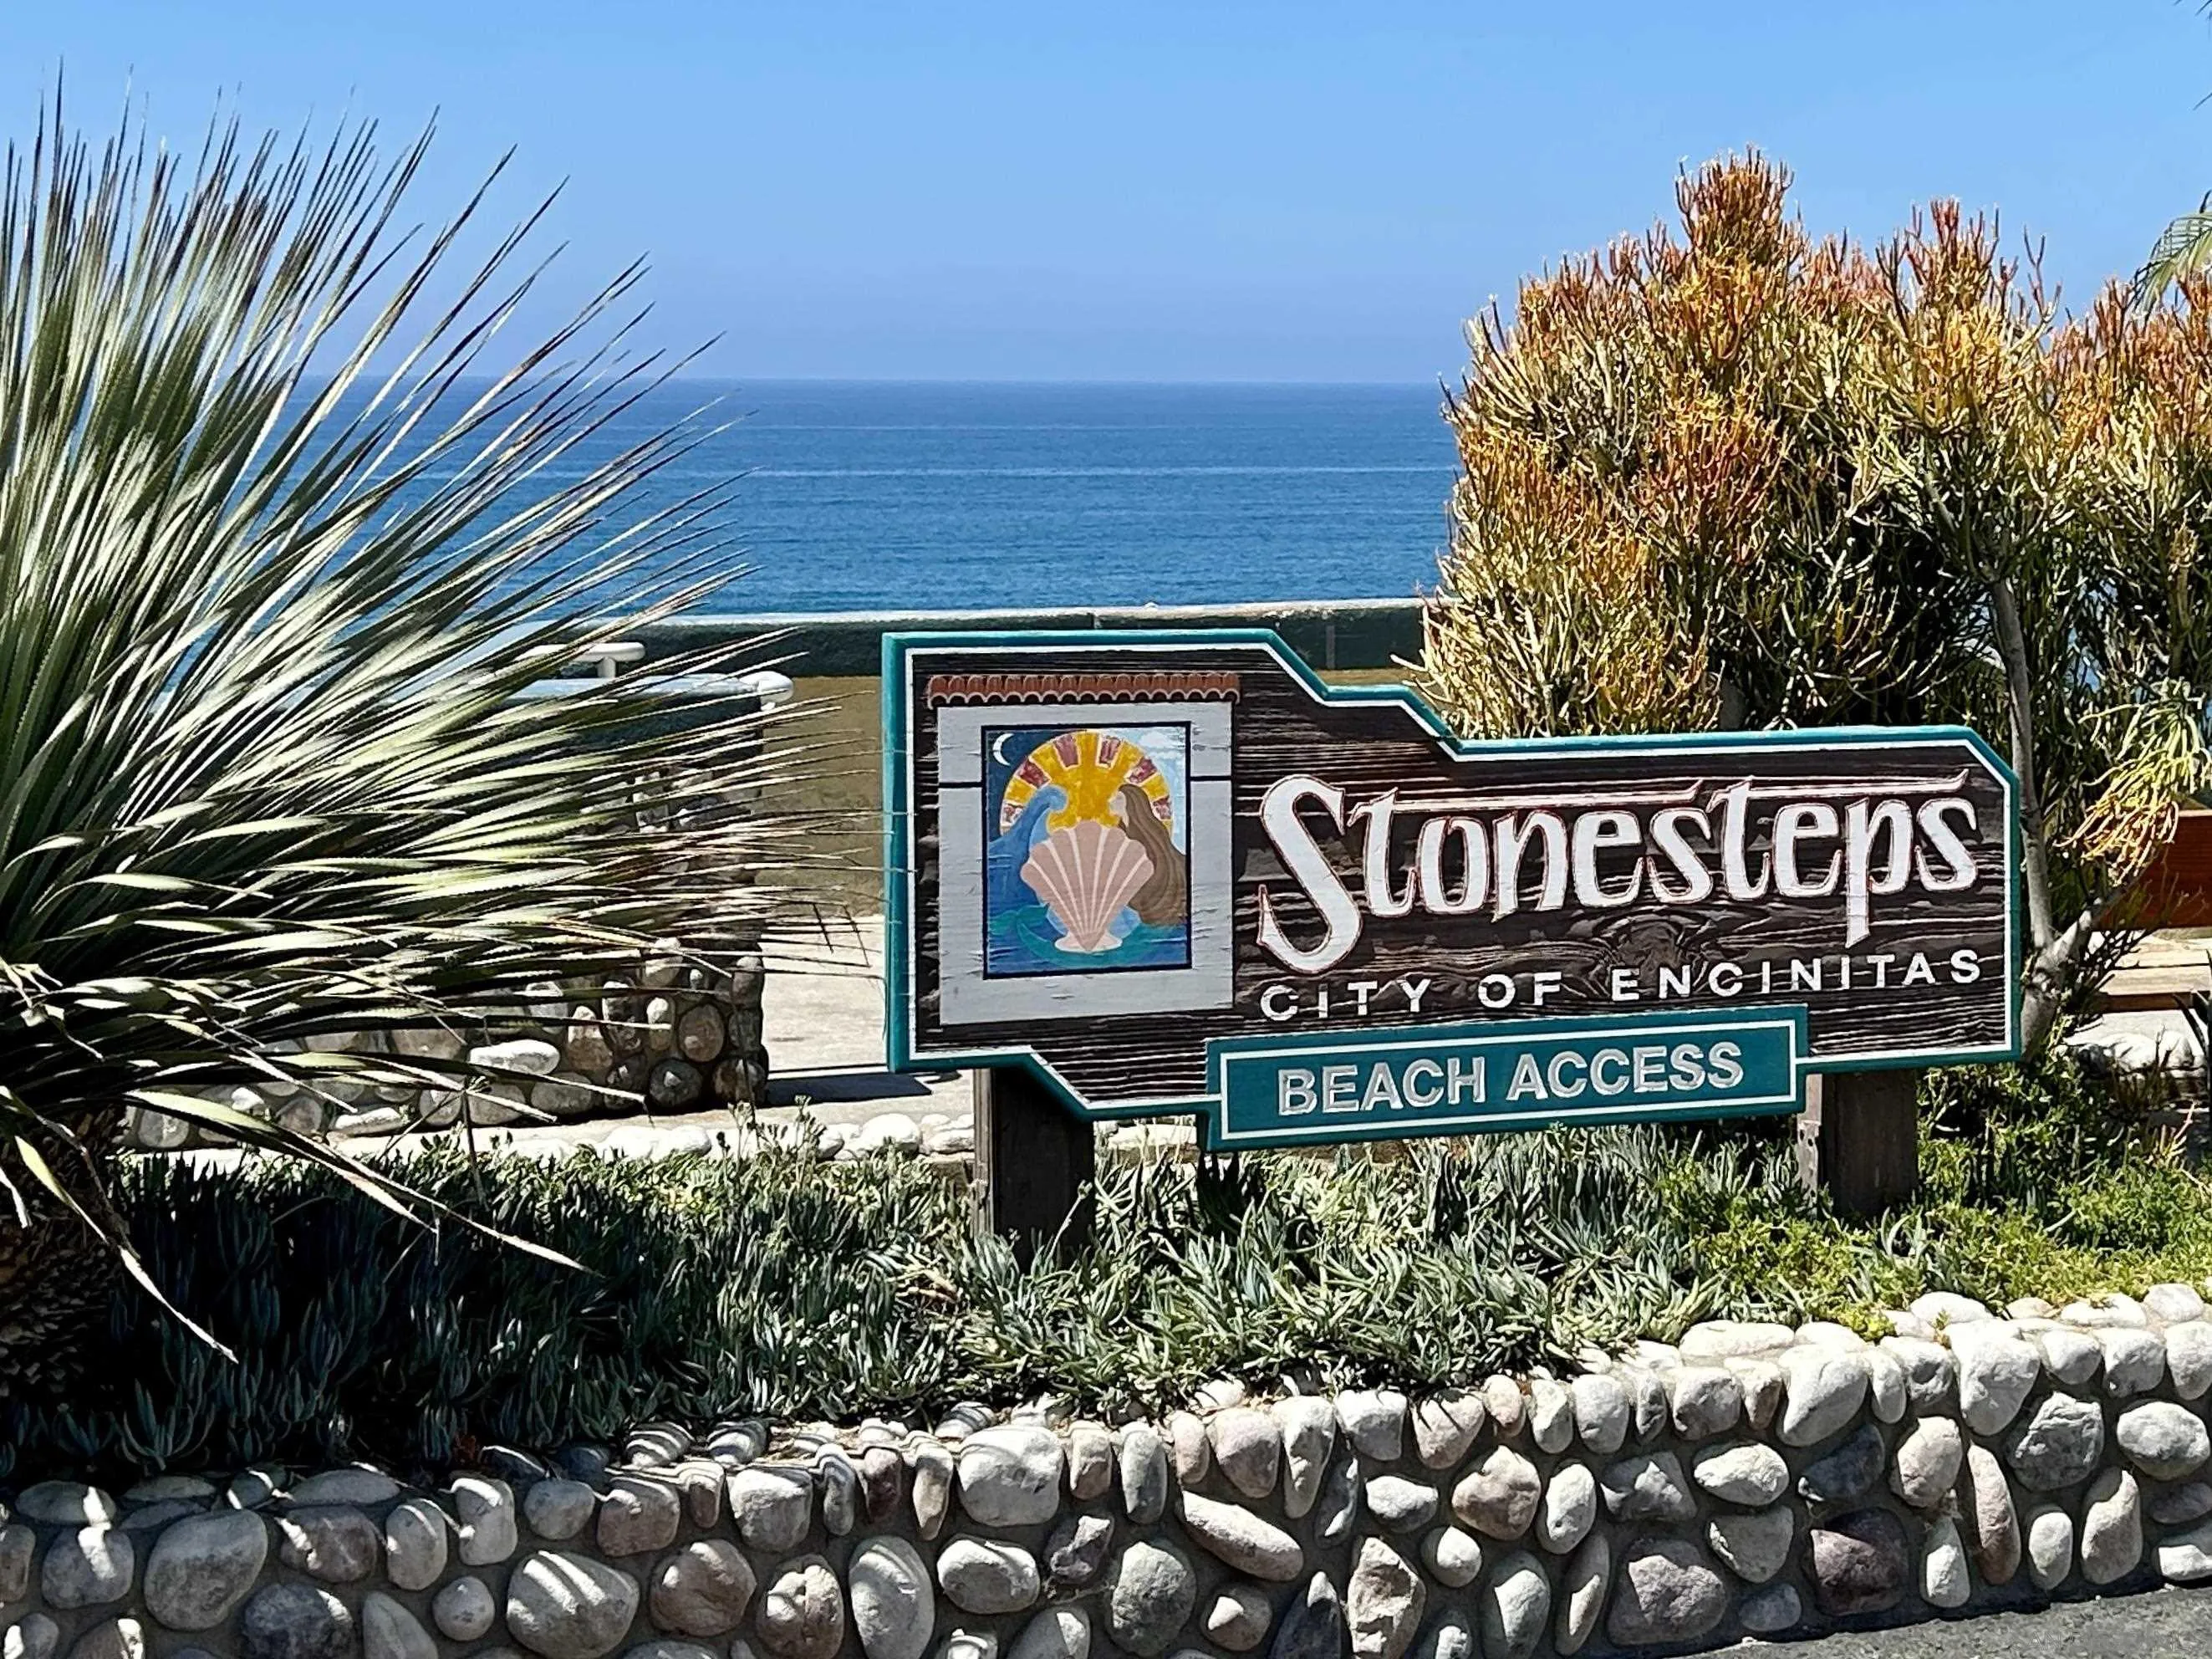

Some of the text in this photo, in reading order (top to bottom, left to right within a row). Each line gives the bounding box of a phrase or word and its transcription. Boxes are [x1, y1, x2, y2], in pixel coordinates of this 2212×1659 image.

[1256, 768, 1980, 973] Stonesteps
[1260, 948, 1981, 1022] CITY OF ENCINITAS
[1278, 1040, 1745, 1116] BEACH ACCESS
